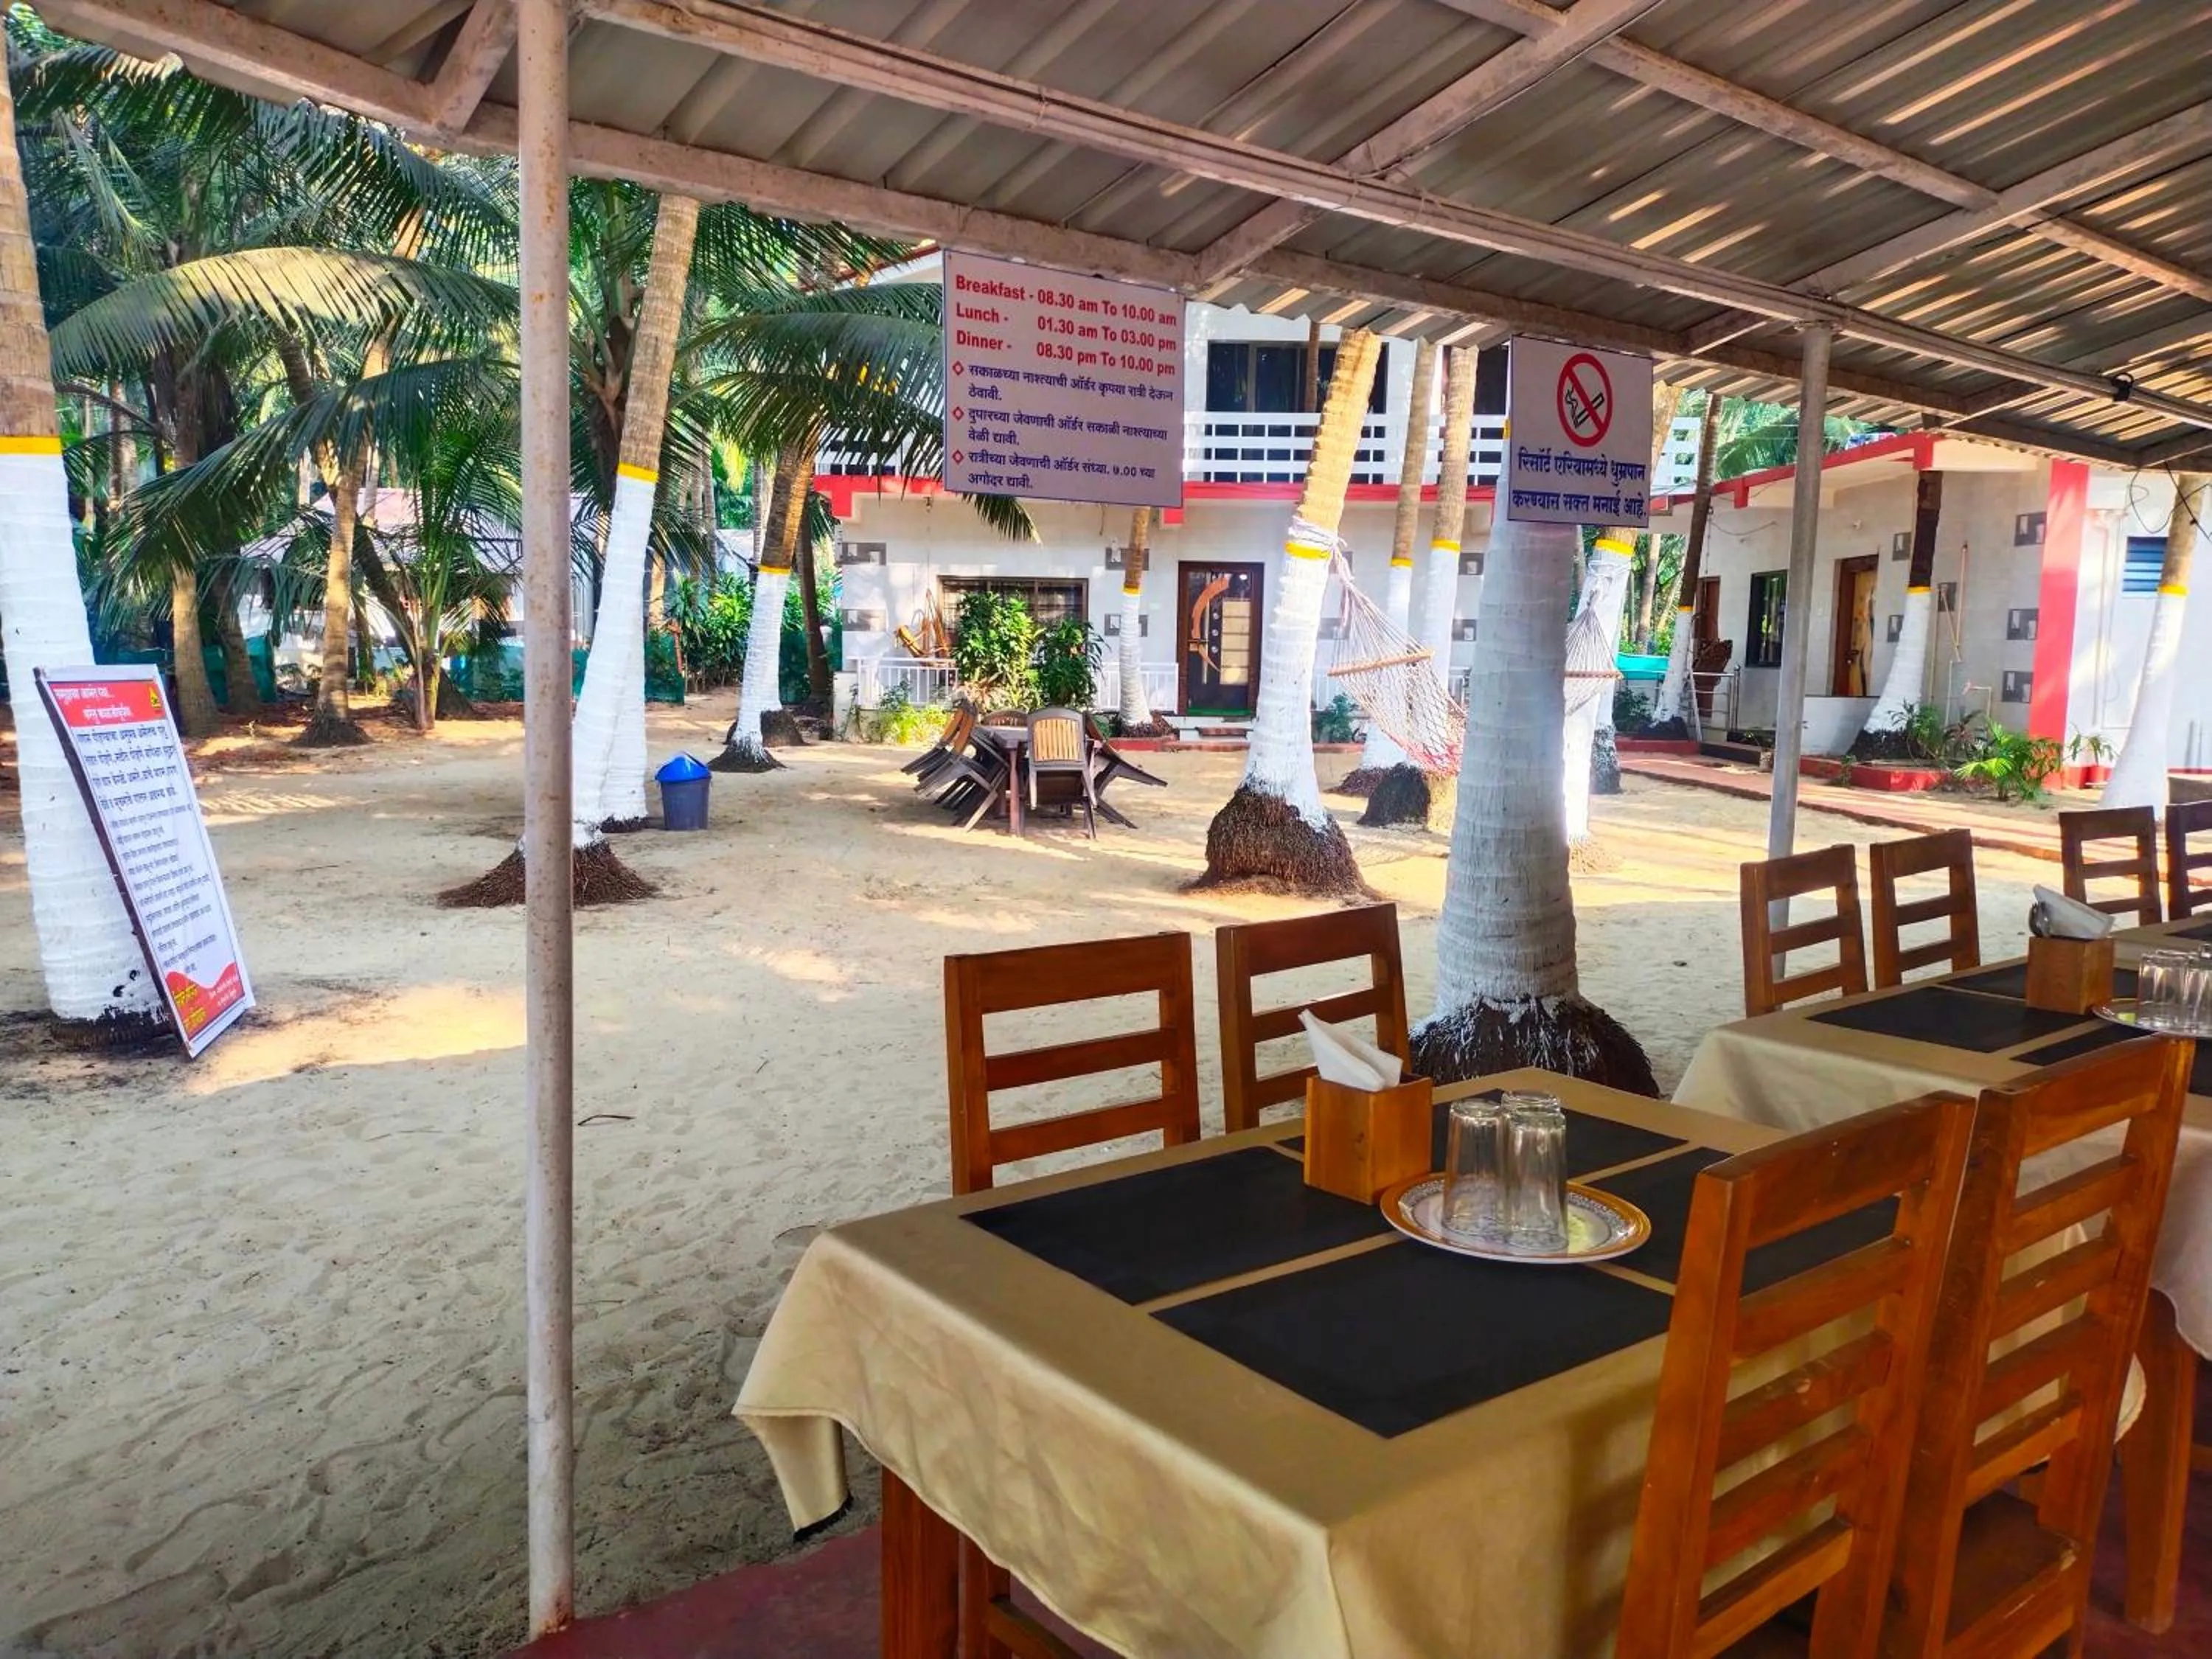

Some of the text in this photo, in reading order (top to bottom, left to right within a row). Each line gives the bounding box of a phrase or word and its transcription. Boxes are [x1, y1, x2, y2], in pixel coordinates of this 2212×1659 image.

[956, 274, 1026, 300] Breakfast
[1037, 289, 1074, 308] 08.30
[1078, 299, 1098, 313] am
[1102, 301, 1117, 316] To
[1121, 304, 1155, 321] 10.00
[1158, 314, 1177, 326] am
[956, 302, 999, 323] Lunch
[1037, 316, 1074, 334] 01.30
[1078, 326, 1098, 339] am
[1102, 326, 1117, 341] To
[1121, 330, 1154, 347] 03.00
[1158, 338, 1177, 352] pm
[956, 330, 1004, 350] Dinner
[1036, 341, 1073, 361] 08.30
[1077, 352, 1096, 365] pm
[1100, 352, 1116, 366] To
[1120, 355, 1153, 372] 10.00
[1157, 365, 1175, 377] pm
[967, 364, 1020, 381] सकाळच्या
[1023, 372, 1068, 388] नाश्त्याची
[1071, 375, 1096, 392] ऑर्डर
[1127, 383, 1147, 397] रात्री
[1149, 386, 1174, 401] देऊन
[967, 383, 1003, 401] ठेवावी.
[967, 408, 1168, 440] दुपारच्या जेवणाची ऑर्डर सकाळी नाश्त्याच्या
[967, 426, 1020, 445] वेळी द्यावी.
[967, 448, 1006, 465] रात्रीच्या
[1009, 452, 1051, 470] जेवणाची
[1054, 456, 1079, 472] ऑर्डर
[1139, 467, 1155, 479] च्या
[1517, 446, 1551, 473] रिसॉर्ट
[1554, 451, 1608, 478] एरियामध्ये
[967, 470, 1034, 488] अगोदर द्यावी.
[1512, 490, 1561, 510] करण्यास
[1562, 493, 1590, 512] सक्त
[1592, 490, 1621, 517] मनाई
